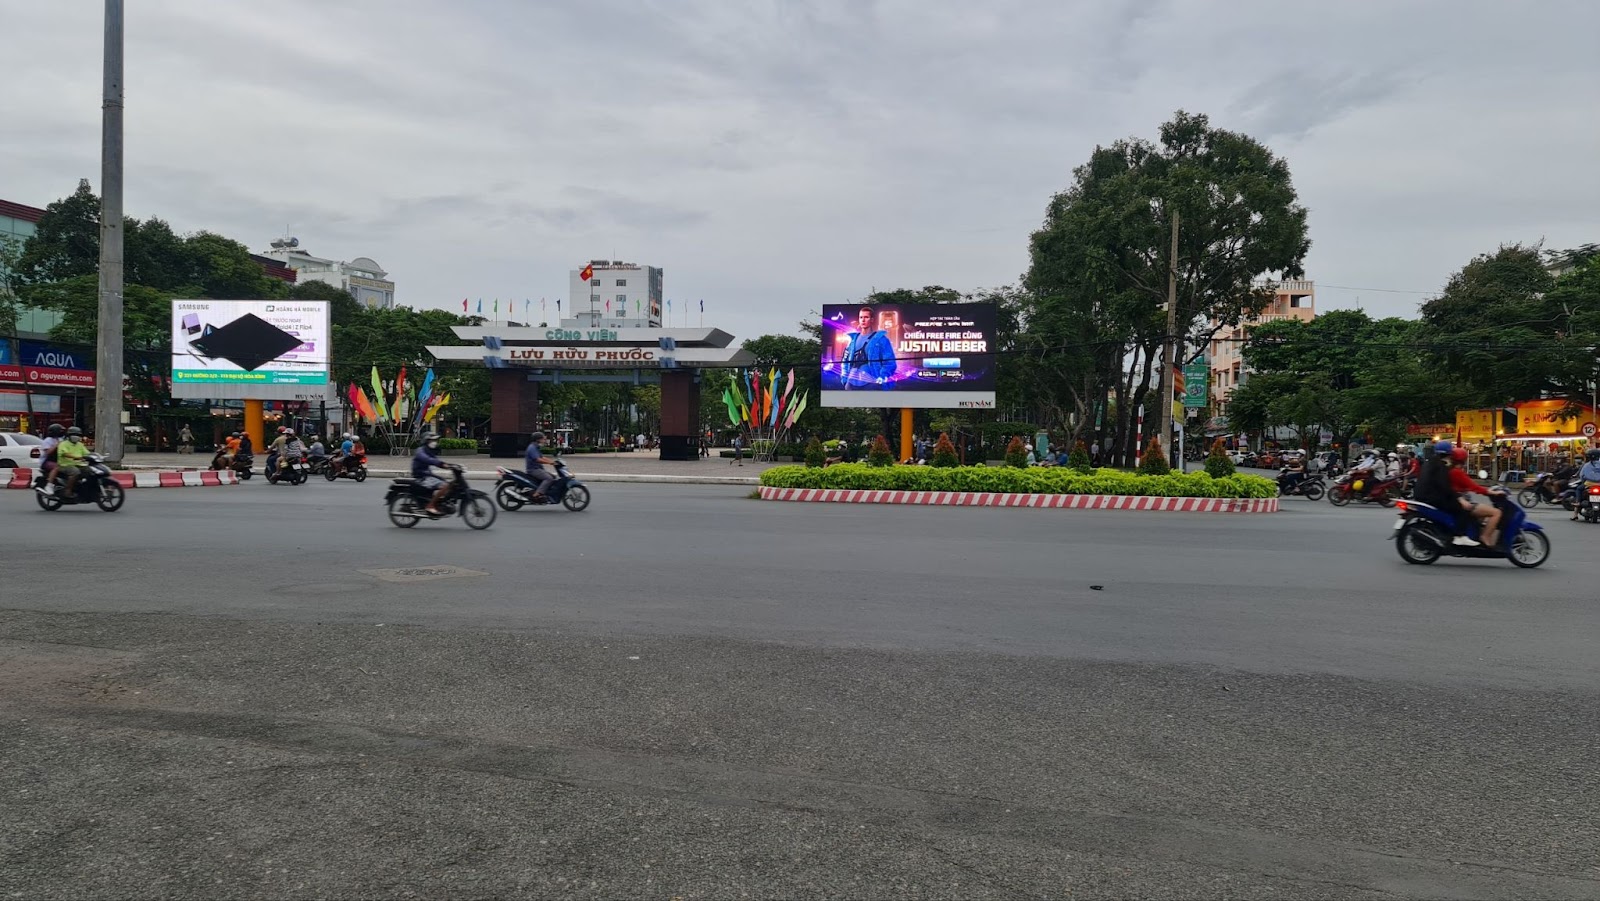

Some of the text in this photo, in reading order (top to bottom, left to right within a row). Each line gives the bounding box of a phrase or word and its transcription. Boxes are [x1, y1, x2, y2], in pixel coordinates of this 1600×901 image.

[545, 329, 618, 340] CÔNG VIÊN
[904, 330, 925, 339] CHIẾN
[962, 331, 982, 339] CÙNG
[898, 341, 986, 352] JUSTIN BIEBER
[510, 348, 654, 359] LƯU HỮU PHƯỚC
[36, 352, 75, 368] AQUA
[40, 372, 93, 382] nguyenkim.com
